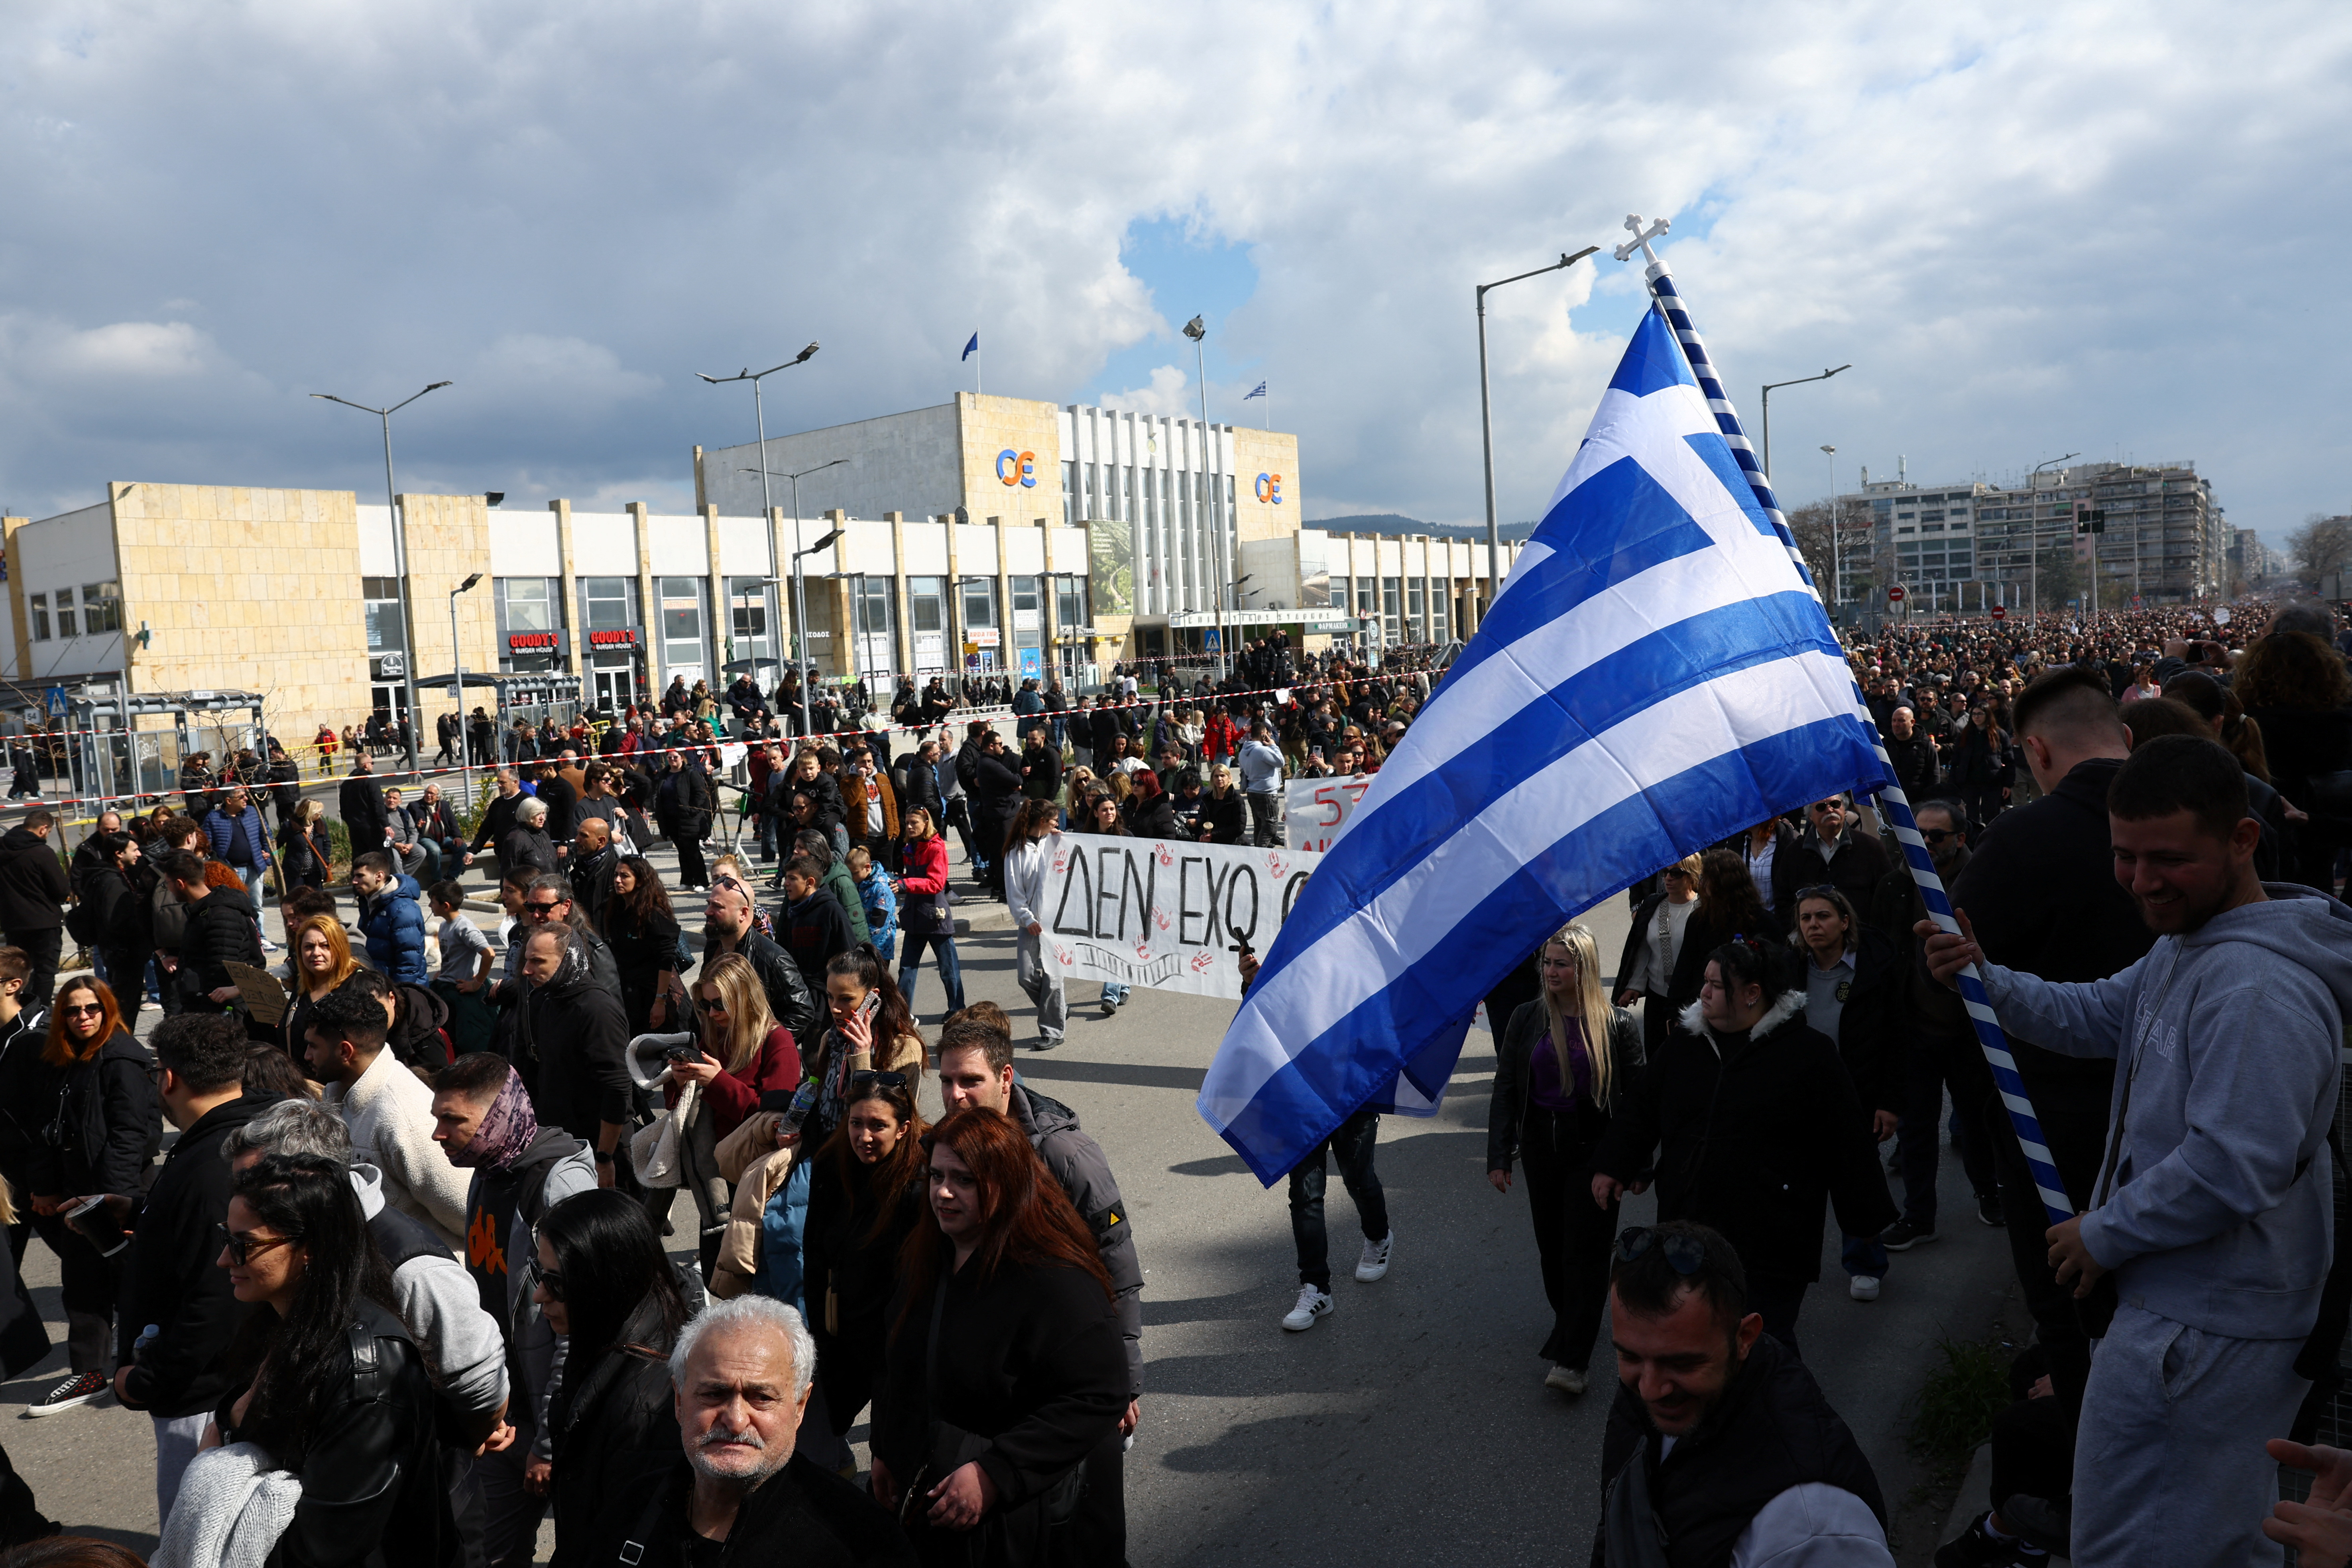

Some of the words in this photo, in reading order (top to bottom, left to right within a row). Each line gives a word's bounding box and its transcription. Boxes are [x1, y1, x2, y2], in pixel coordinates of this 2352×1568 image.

[1188, 614, 1270, 624] ΕΠΙΑΤΙΚΟΣ
[510, 632, 559, 647] GOODY'S
[590, 629, 636, 644] GOODY'S
[1314, 783, 1369, 827] 57
[1052, 844, 1155, 941] ΔΕΝ
